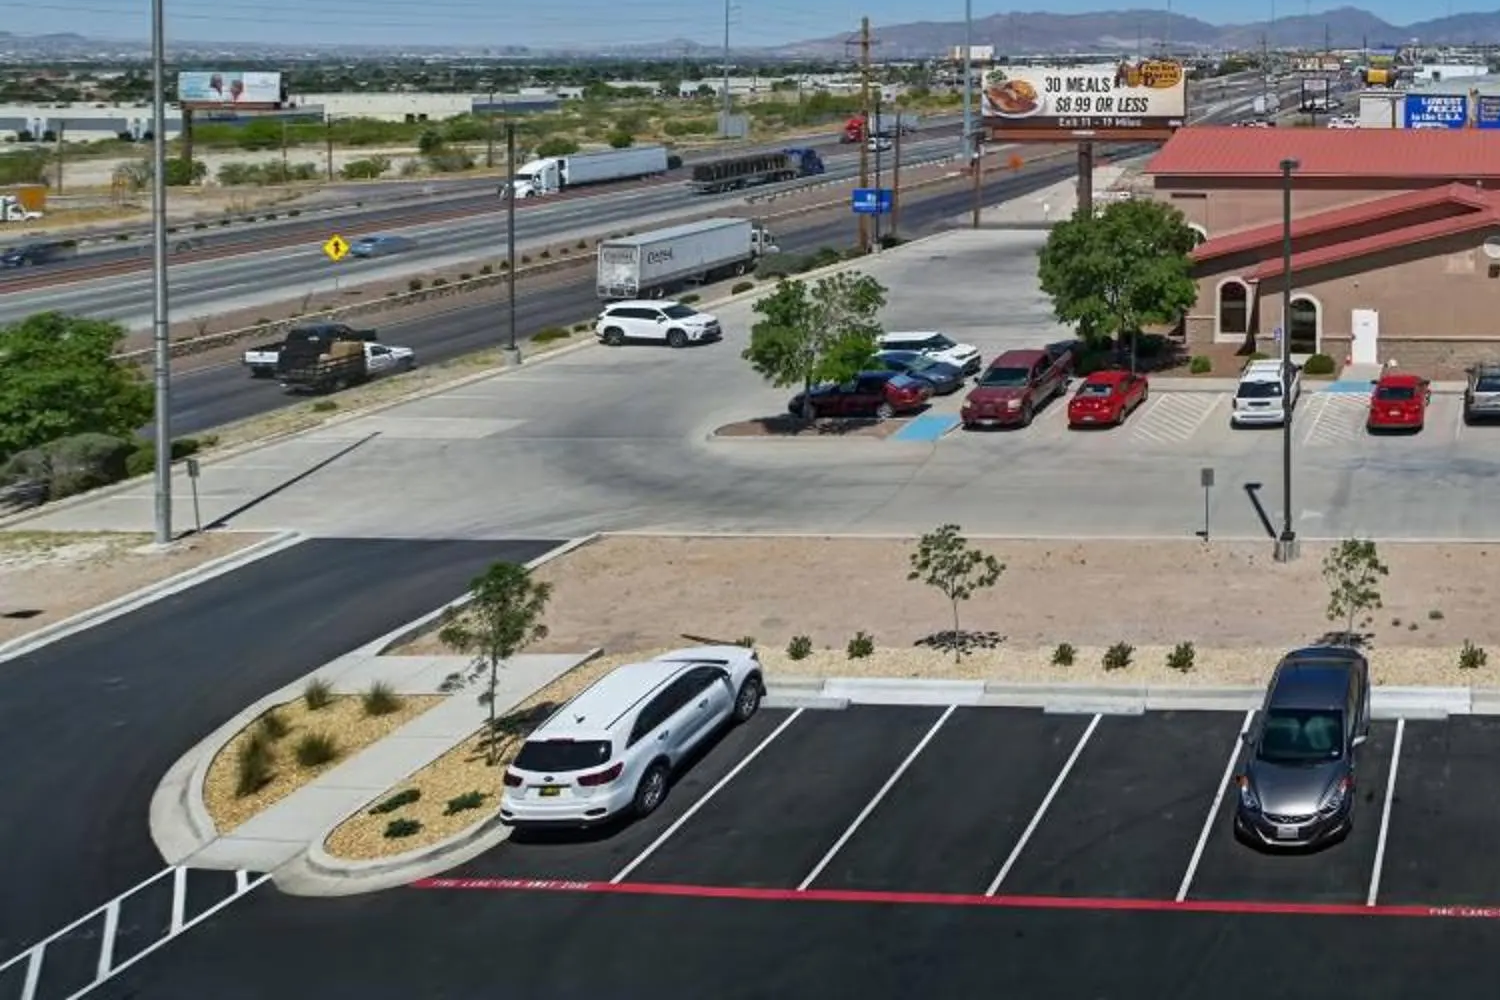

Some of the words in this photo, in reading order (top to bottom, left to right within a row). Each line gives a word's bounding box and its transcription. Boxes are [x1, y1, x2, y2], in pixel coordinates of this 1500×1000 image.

[1045, 77, 1061, 93] 30
[1066, 77, 1111, 93] MEALS
[1056, 97, 1091, 113] $8.99
[1095, 98, 1114, 113] OR
[1117, 97, 1149, 113] LESS
[1421, 97, 1462, 105] LOWEST
